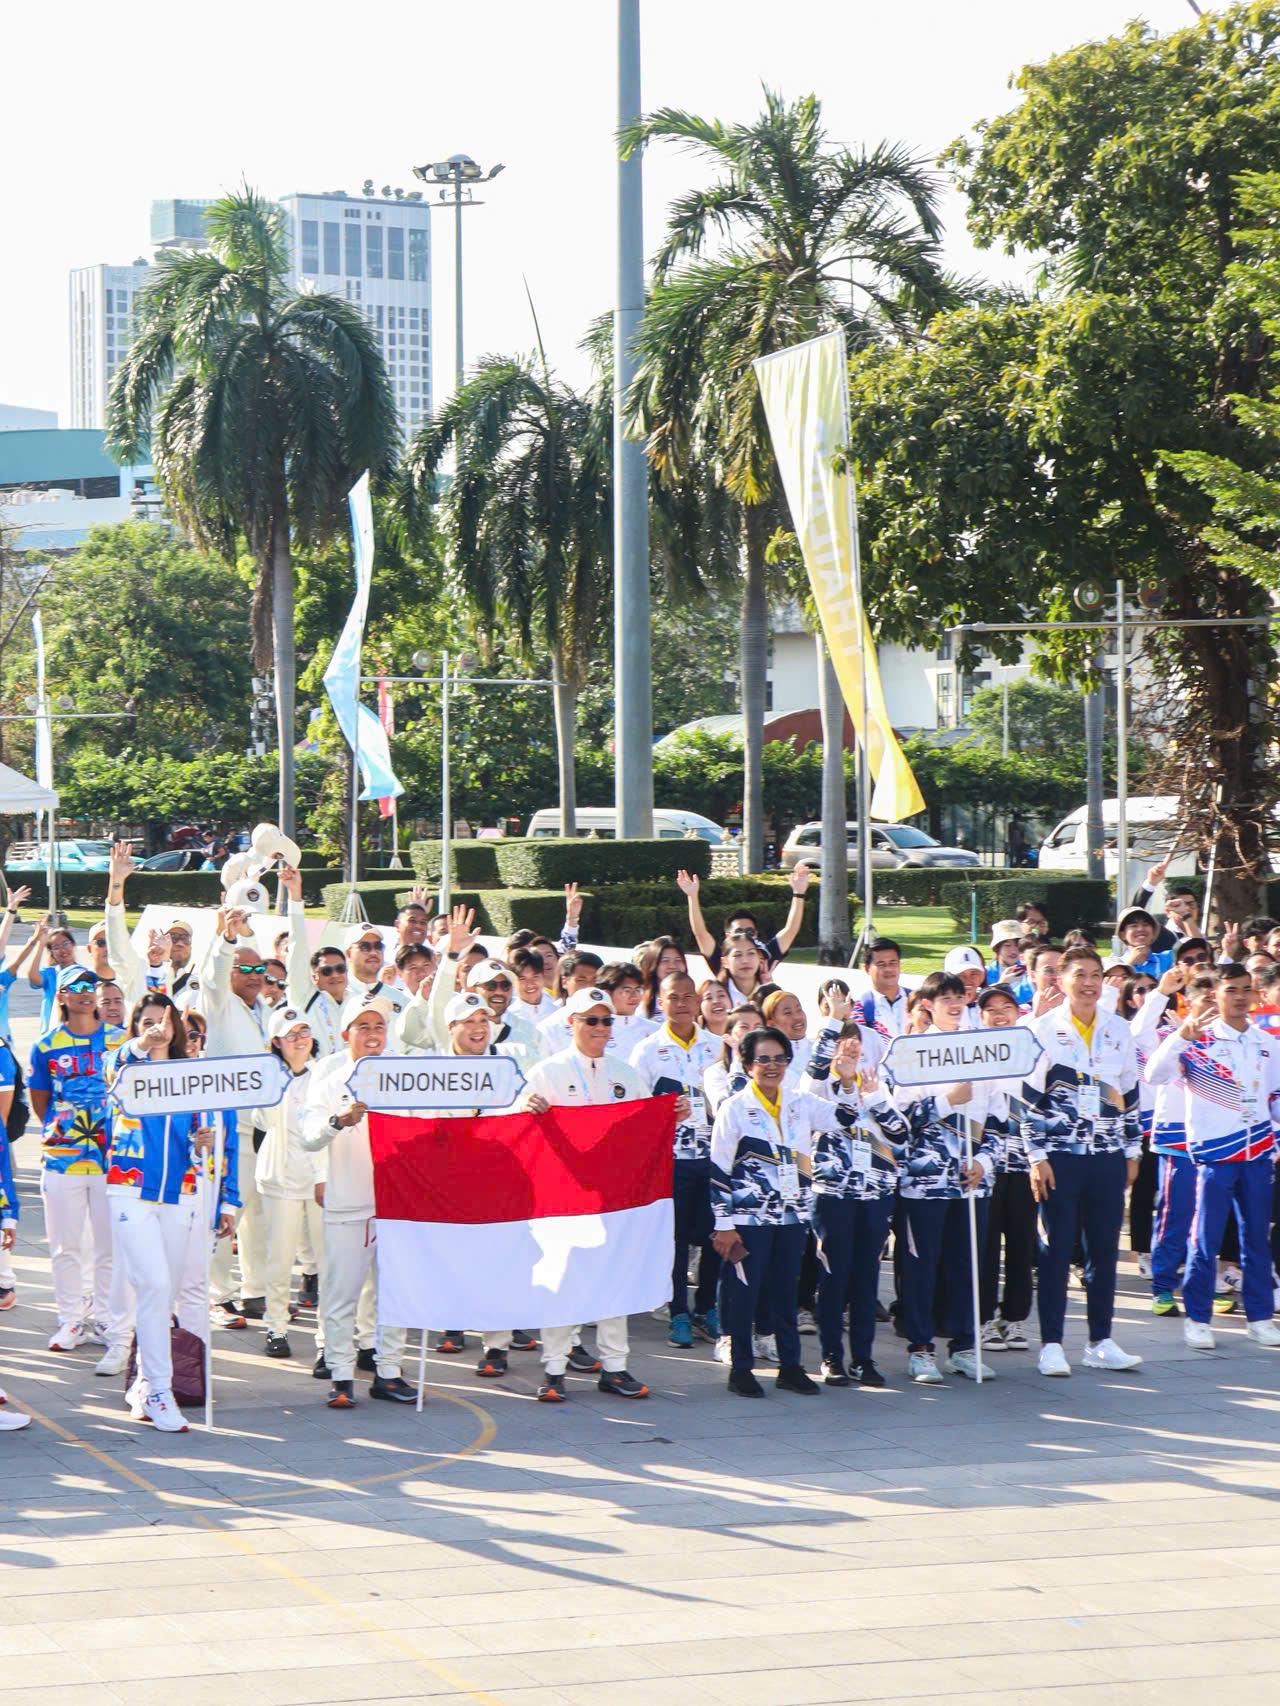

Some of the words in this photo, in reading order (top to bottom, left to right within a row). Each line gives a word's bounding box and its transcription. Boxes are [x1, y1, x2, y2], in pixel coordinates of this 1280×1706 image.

[915, 1043, 1011, 1068] THAILAND
[133, 1070, 263, 1099] PHILIPPINES
[379, 1072, 494, 1092] INDONESIA
